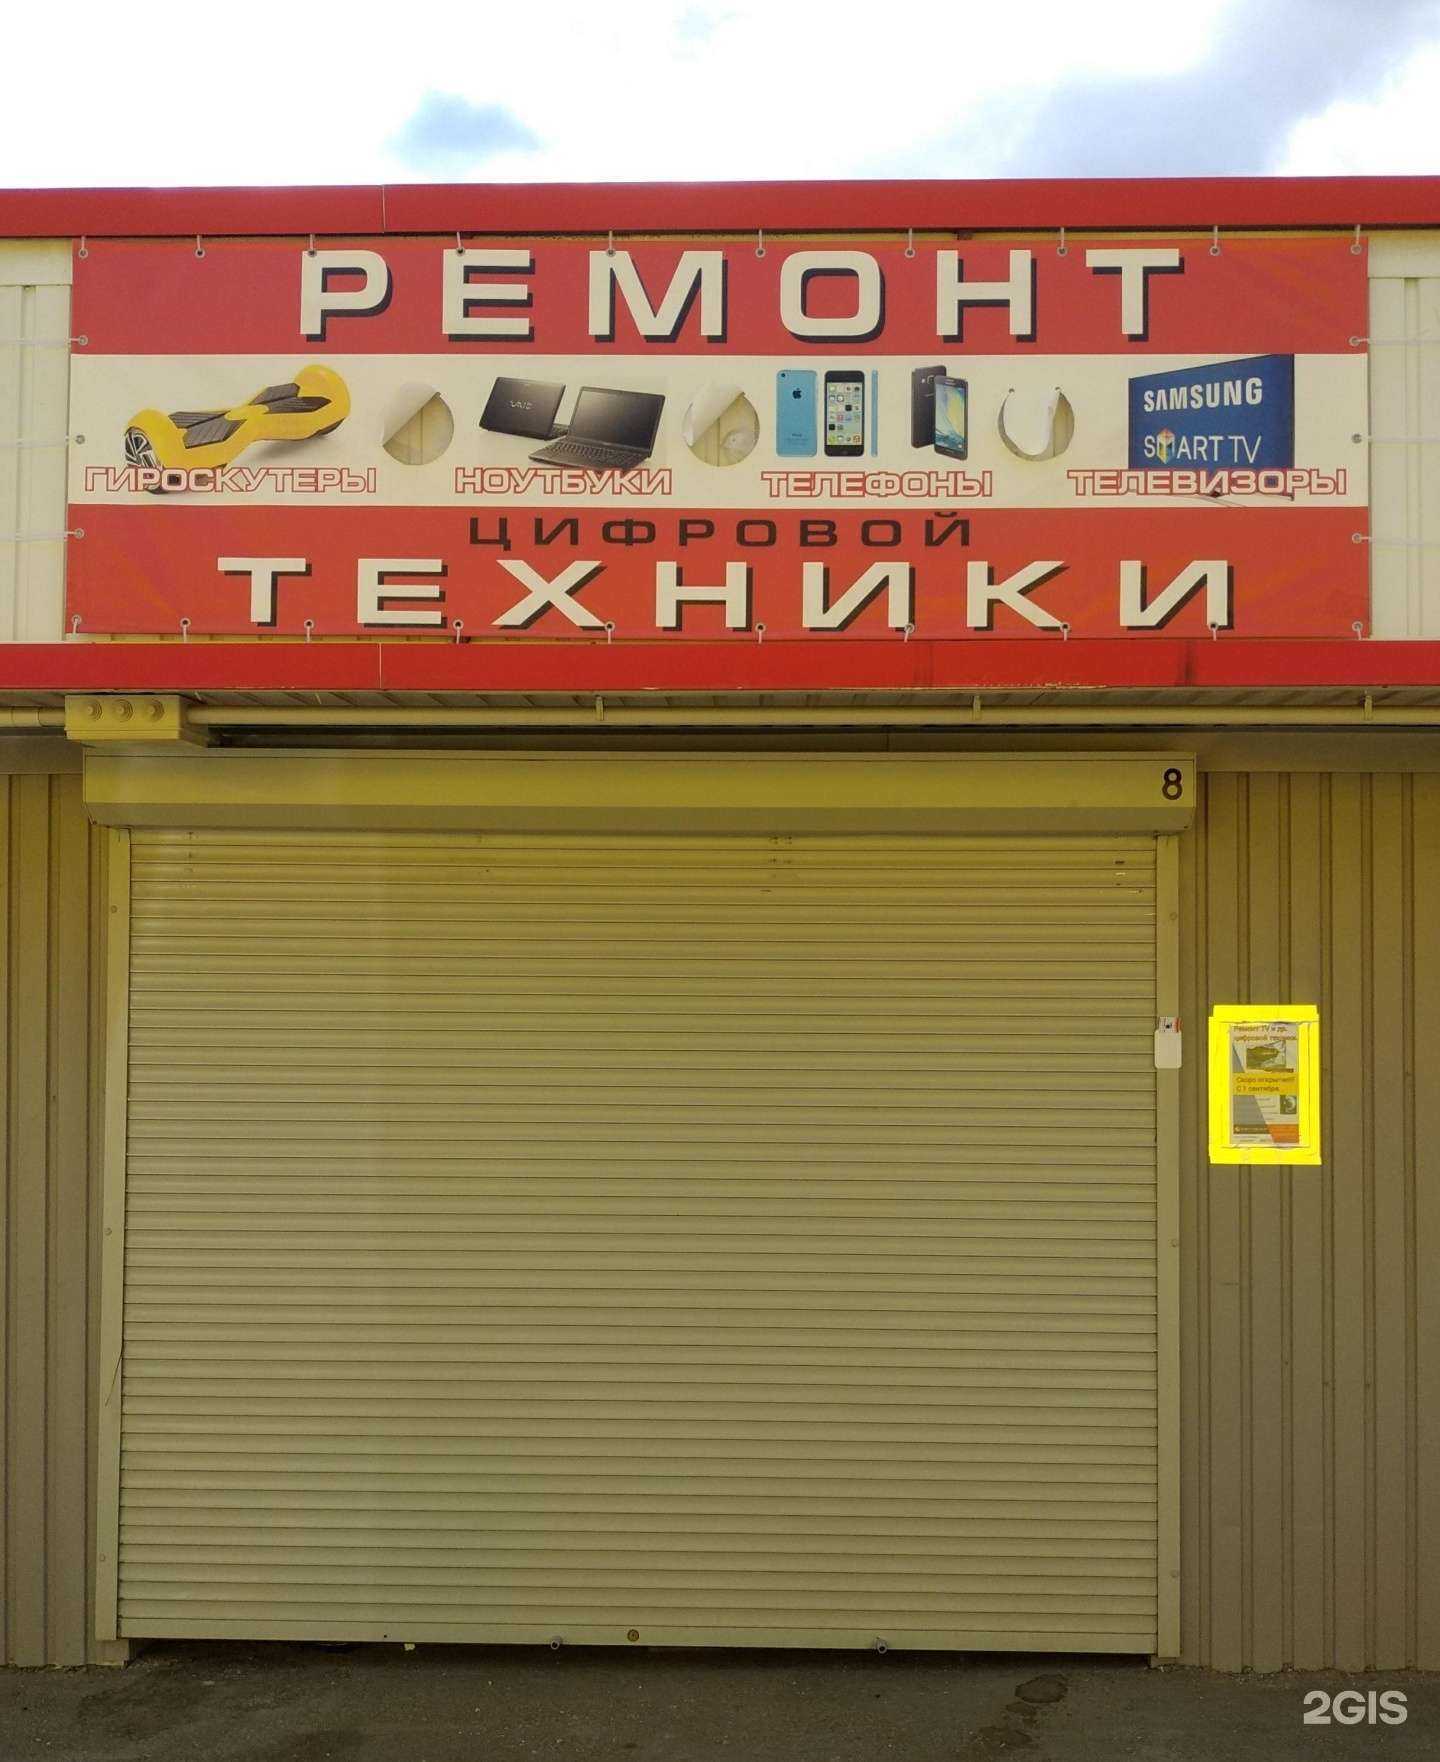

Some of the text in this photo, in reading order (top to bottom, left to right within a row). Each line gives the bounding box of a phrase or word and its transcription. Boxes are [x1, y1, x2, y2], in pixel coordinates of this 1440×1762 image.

[300, 248, 1184, 341] РЕМОНТ
[1143, 377, 1263, 413] SAMSUNG
[1143, 428, 1262, 464] SMART TV
[84, 466, 377, 494] ГИРОСКУТЕРЫ
[454, 467, 673, 496] НОУТБУКИ
[760, 470, 993, 498] ТЕЛЕФОНЫ
[1067, 468, 1348, 496] ТЕЛЕВИЗОРЫ
[469, 511, 971, 551] ЦИФРОВОЙ
[217, 559, 1234, 631] ТЕХНИКИ
[1162, 768, 1183, 800] 8
